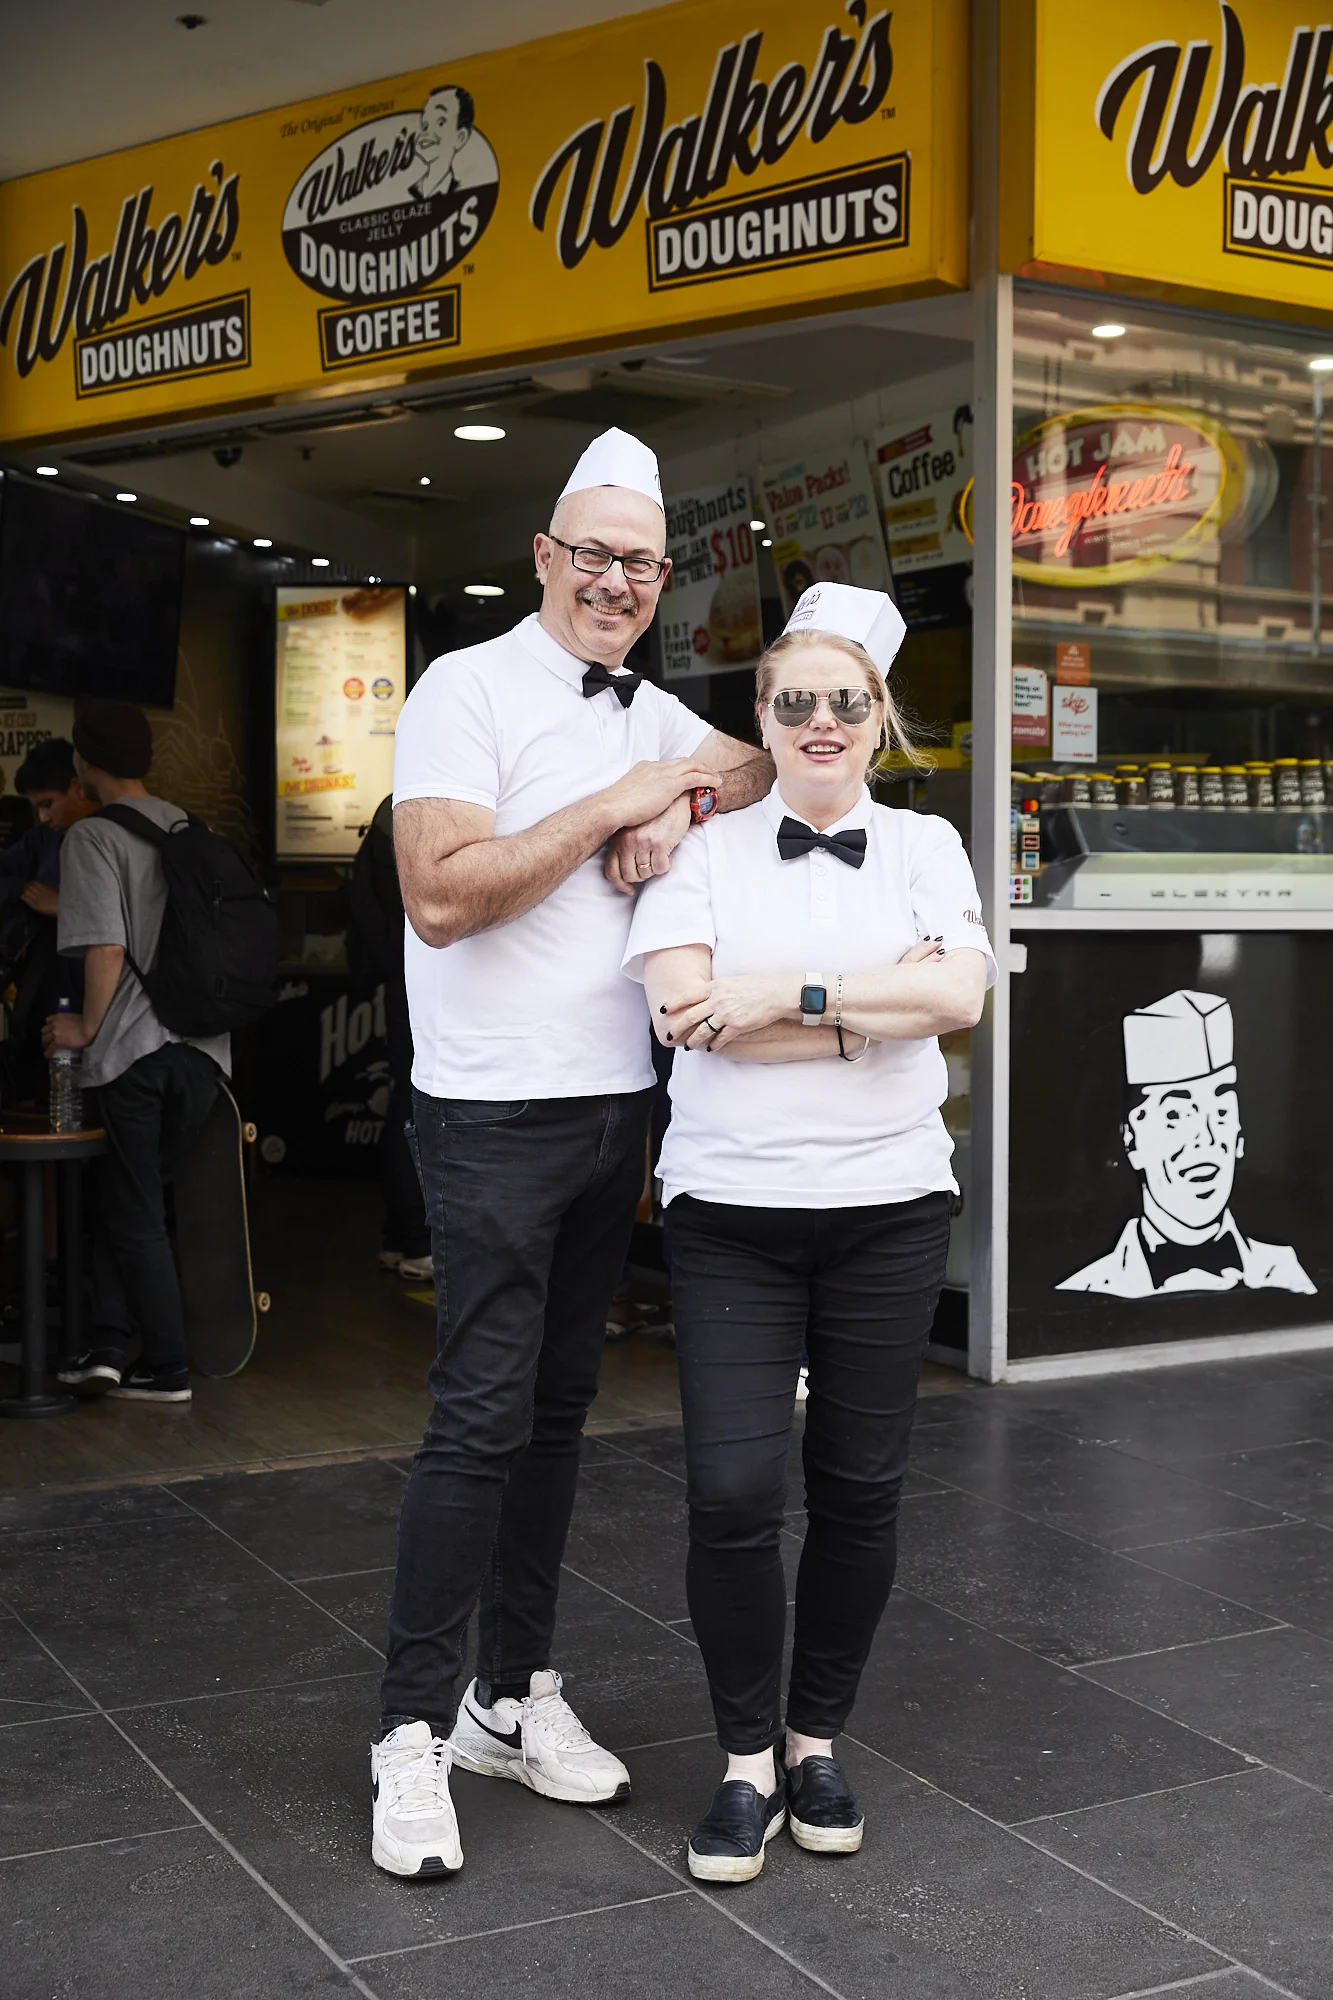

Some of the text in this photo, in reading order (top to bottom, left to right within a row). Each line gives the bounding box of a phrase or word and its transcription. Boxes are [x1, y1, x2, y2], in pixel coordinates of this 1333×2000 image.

[280, 121, 298, 138] The
[301, 107, 345, 133] Original
[528, 0, 894, 270] Walker's
[298, 126, 418, 223] Walker's
[300, 195, 479, 295] DOUGHNUTS
[339, 202, 432, 235] CLASSIC GLAZE
[366, 222, 403, 242] JELLY
[657, 184, 899, 276] DOUGHNUTS
[0, 159, 240, 378] Walker's
[81, 316, 243, 386] DOUGHNUTS
[336, 300, 441, 356] COFFEE
[888, 451, 956, 499] Coffee
[1025, 425, 1168, 481] HOT JAM
[666, 486, 746, 538] oughnuts
[711, 523, 753, 576] $10
[344, 1120, 385, 1145] HOT
